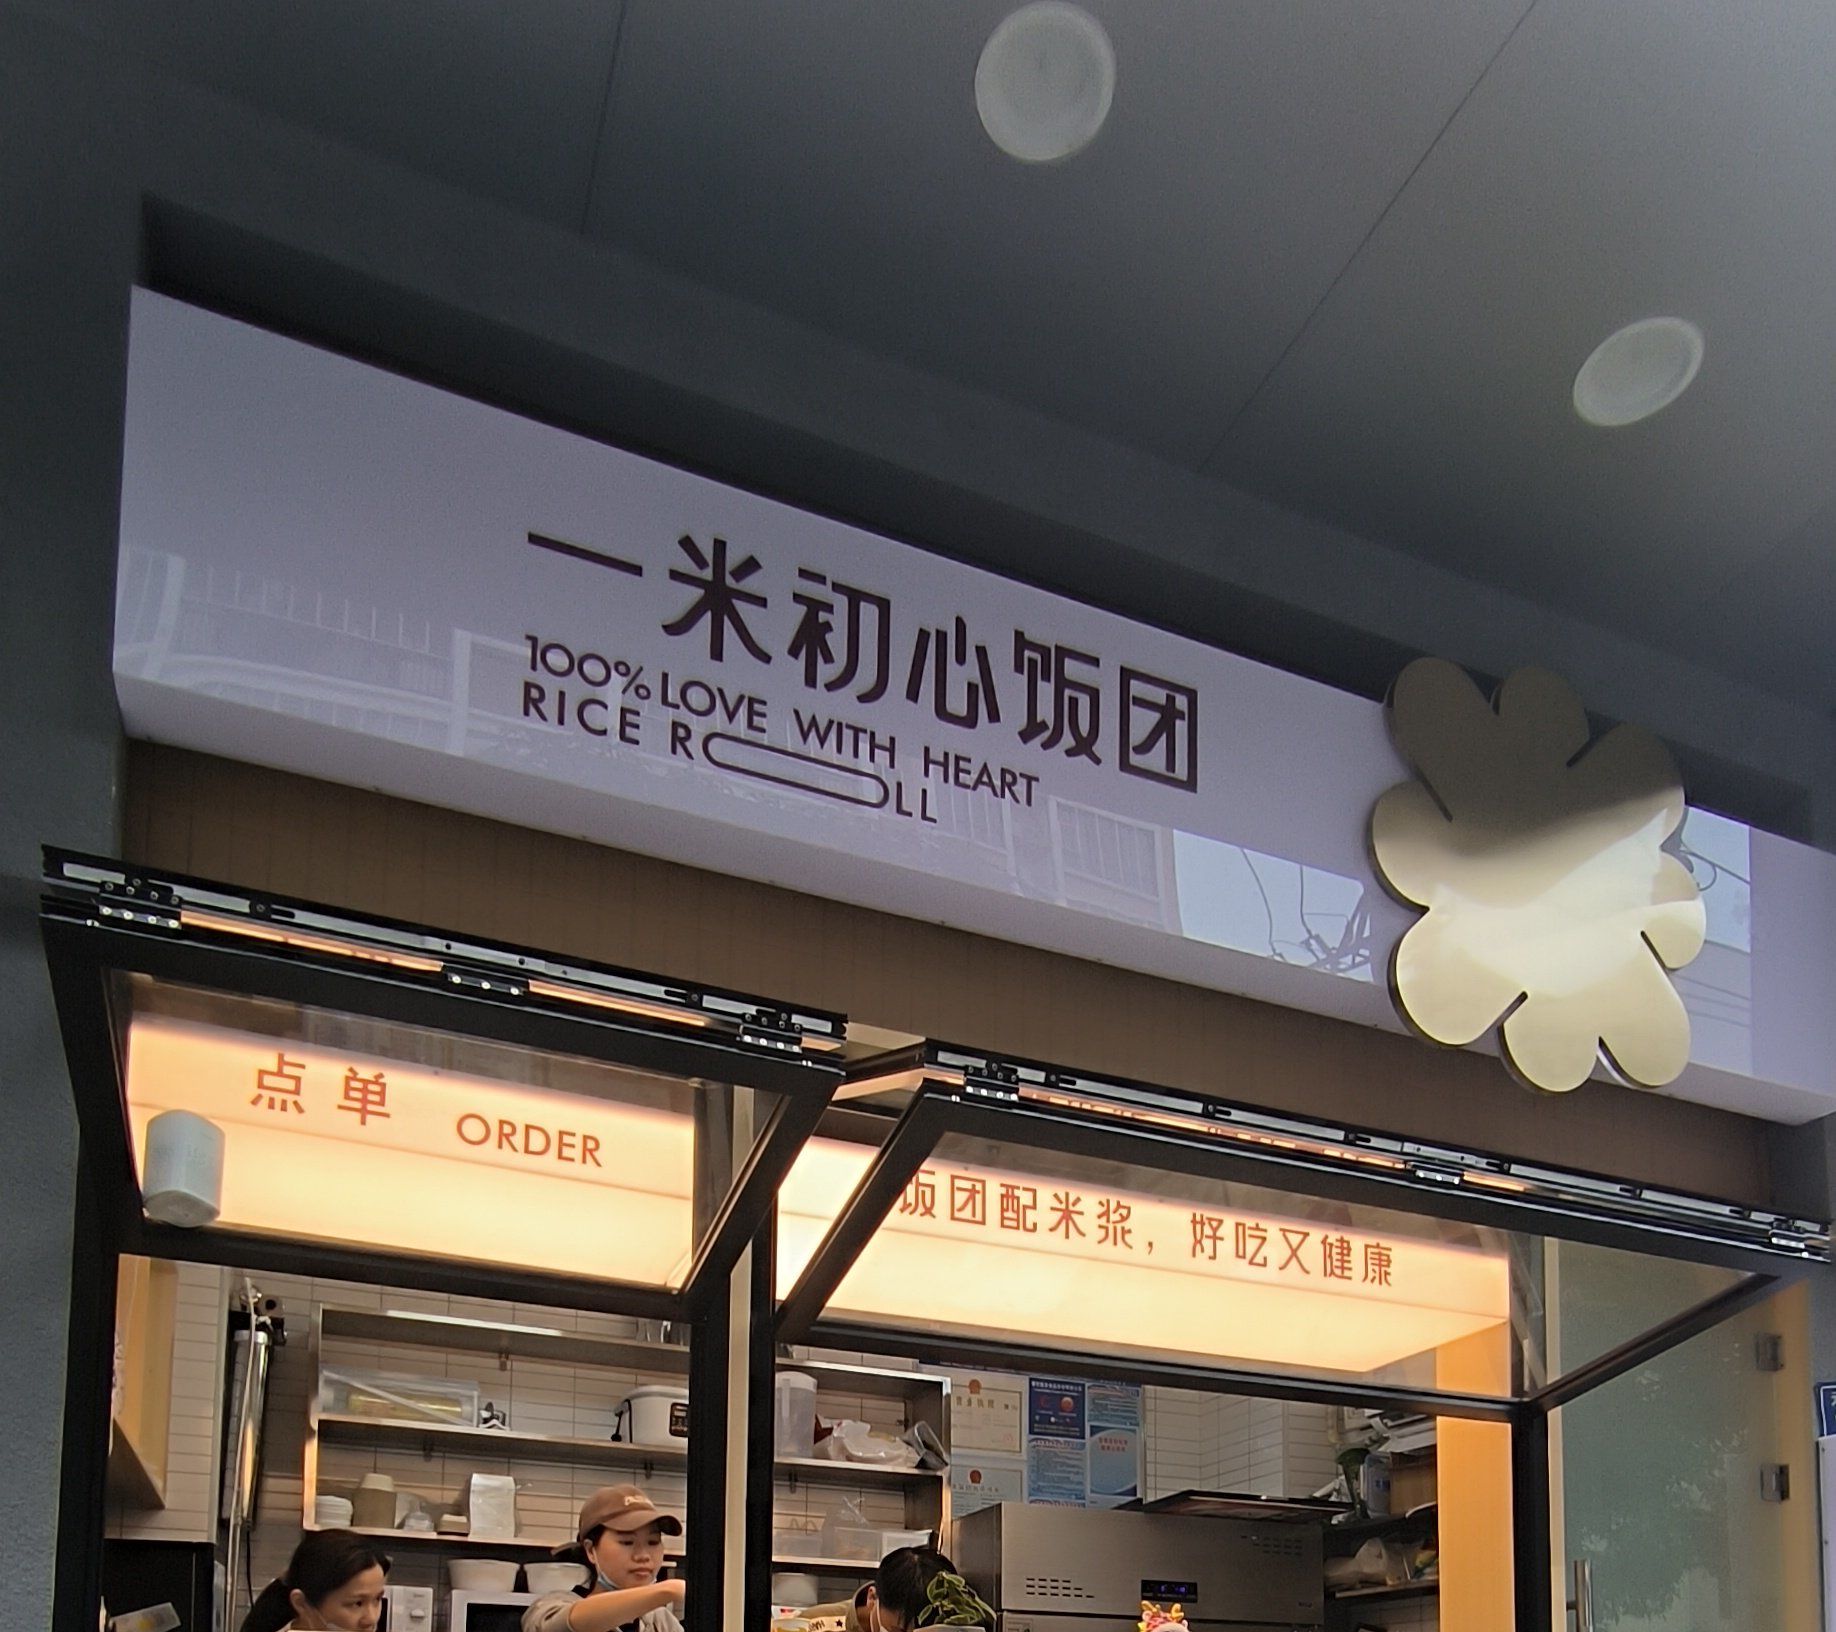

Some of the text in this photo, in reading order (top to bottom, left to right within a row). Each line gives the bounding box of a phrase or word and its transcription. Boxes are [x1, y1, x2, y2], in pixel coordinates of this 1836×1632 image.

[522, 680, 641, 746] RICE
[528, 532, 1198, 793] 一米初心饭团
[661, 672, 768, 735] LOVE
[793, 708, 896, 769] WITH
[923, 746, 1040, 807] HEART
[250, 1052, 602, 1168] 点单 ORDER
